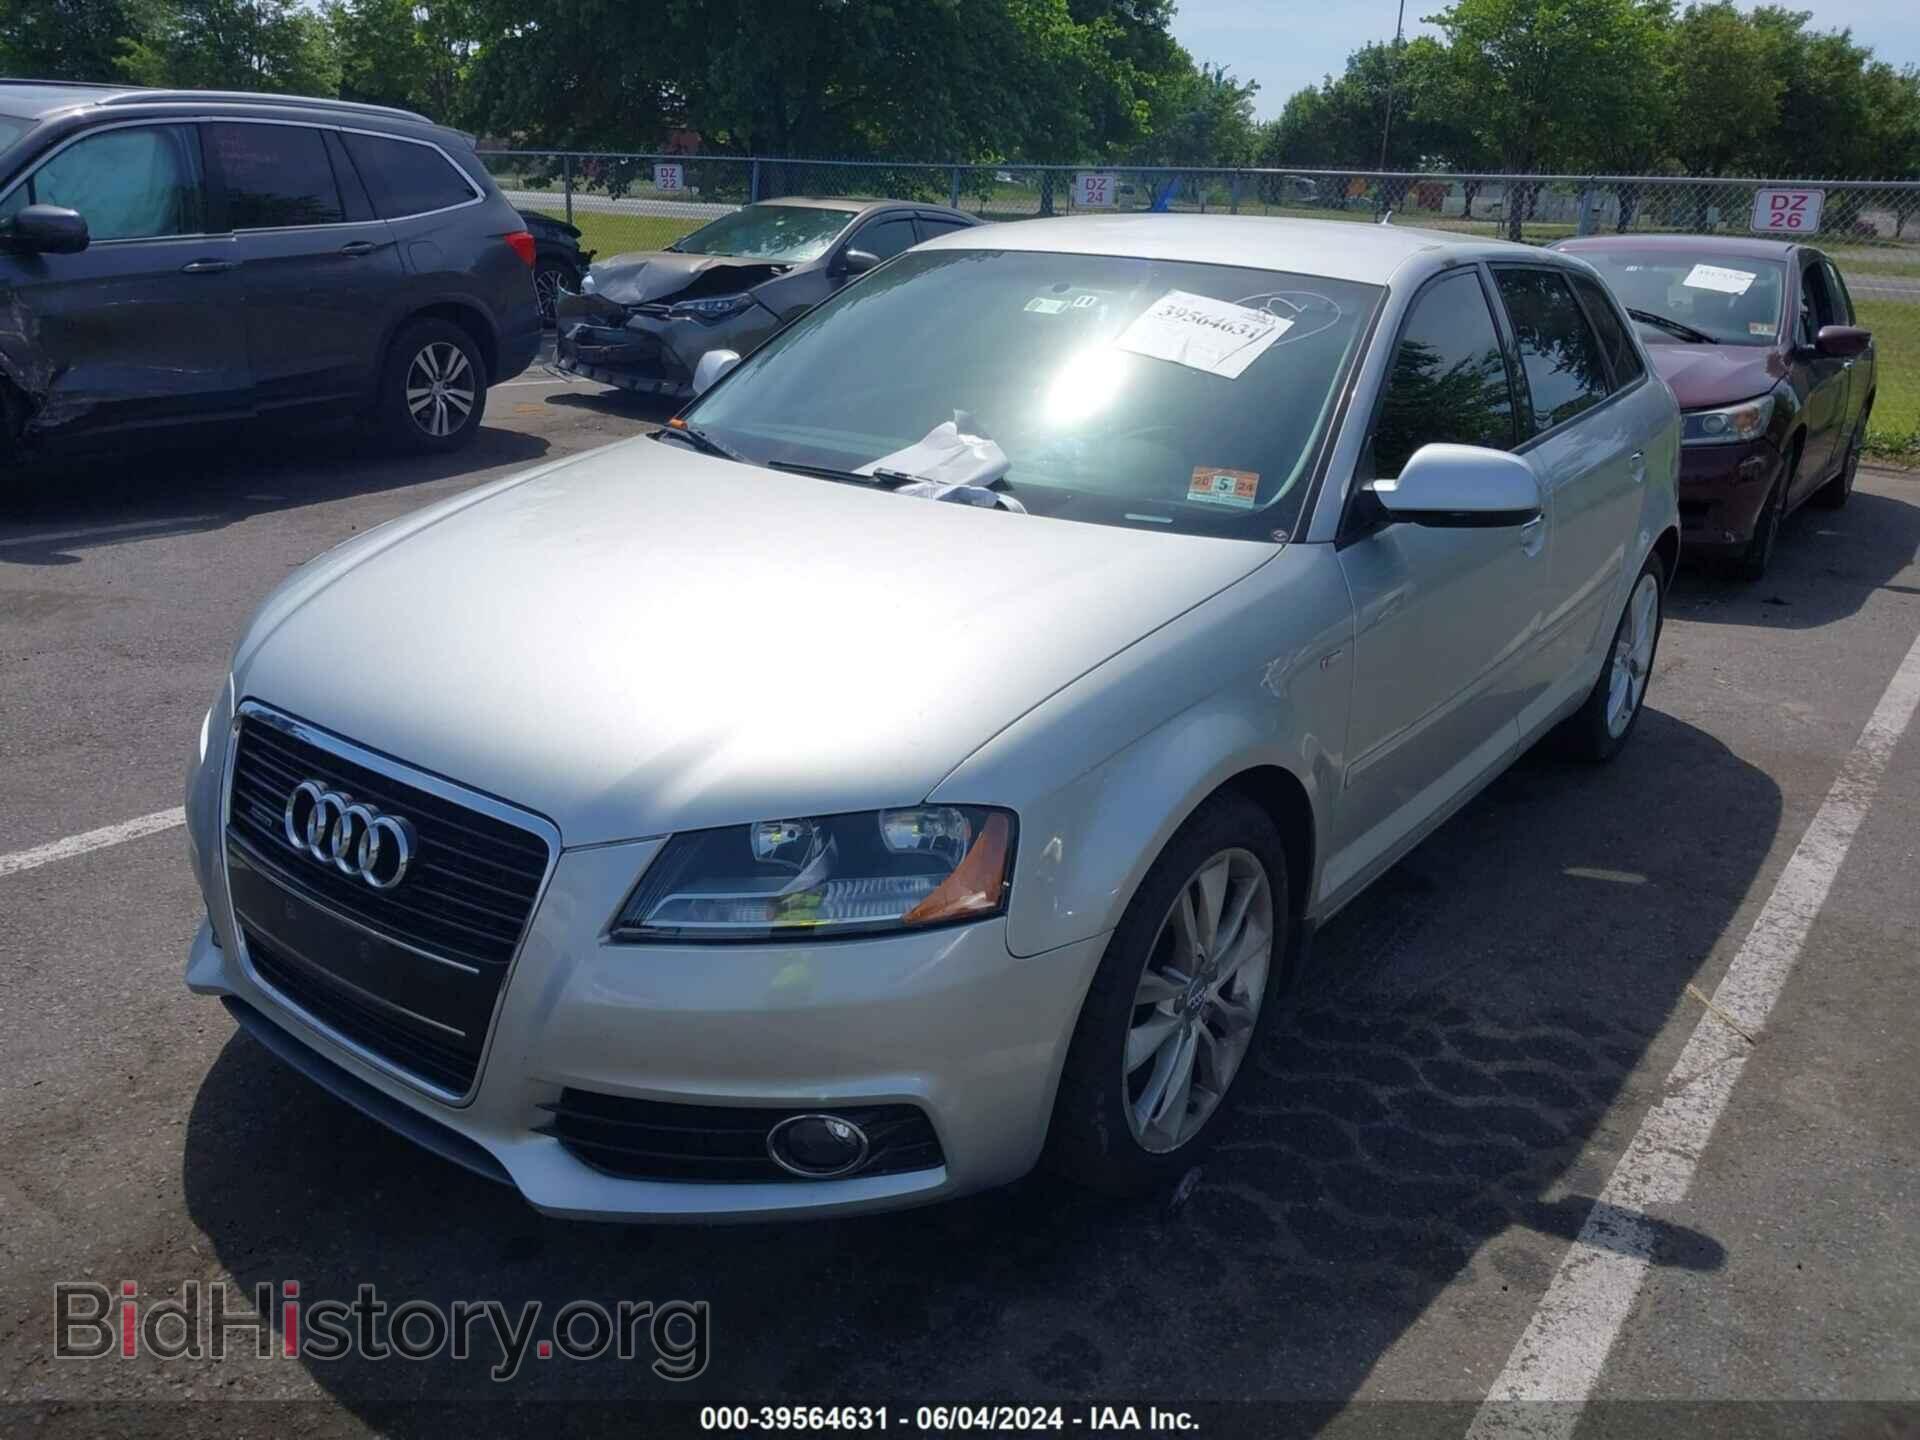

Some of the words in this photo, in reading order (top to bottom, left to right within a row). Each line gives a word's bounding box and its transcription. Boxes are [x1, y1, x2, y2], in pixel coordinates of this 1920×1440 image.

[660, 167, 677, 178] DZ
[1086, 178, 1105, 190] DZ
[1087, 191, 1104, 203] 24
[1770, 194, 1809, 211] DZ
[1769, 212, 1802, 228] 26
[1157, 304, 1261, 339] 39564631
[1218, 478, 1230, 491] 5
